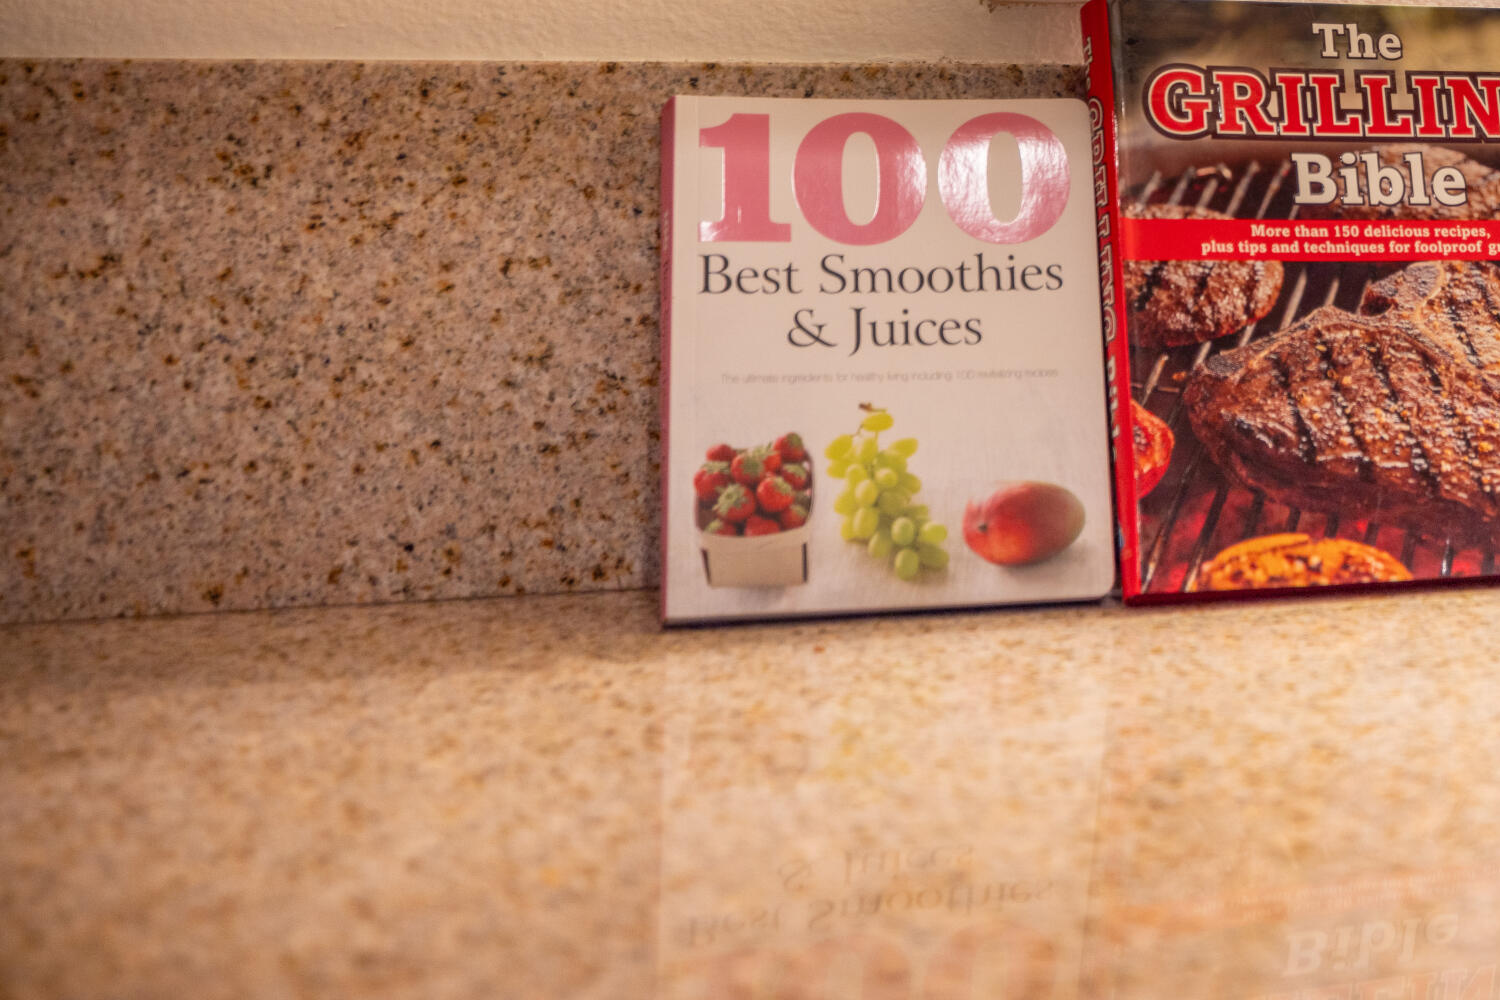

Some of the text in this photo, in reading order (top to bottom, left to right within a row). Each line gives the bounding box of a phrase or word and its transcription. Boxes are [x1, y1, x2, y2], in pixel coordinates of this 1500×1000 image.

[1312, 23, 1403, 60] The
[699, 112, 1070, 246] 100
[1291, 151, 1468, 208] Bible
[1201, 240, 1233, 255] plus
[1238, 240, 1268, 255] tips
[1272, 240, 1299, 253] and
[1303, 240, 1385, 256] techniques
[1389, 240, 1411, 253] for
[1415, 239, 1483, 255] foolproof
[1251, 225, 1491, 240] More than 150 delicious recipes,
[699, 253, 1063, 294] Best Smoothies
[788, 307, 983, 357] & Juices
[721, 373, 740, 384] The
